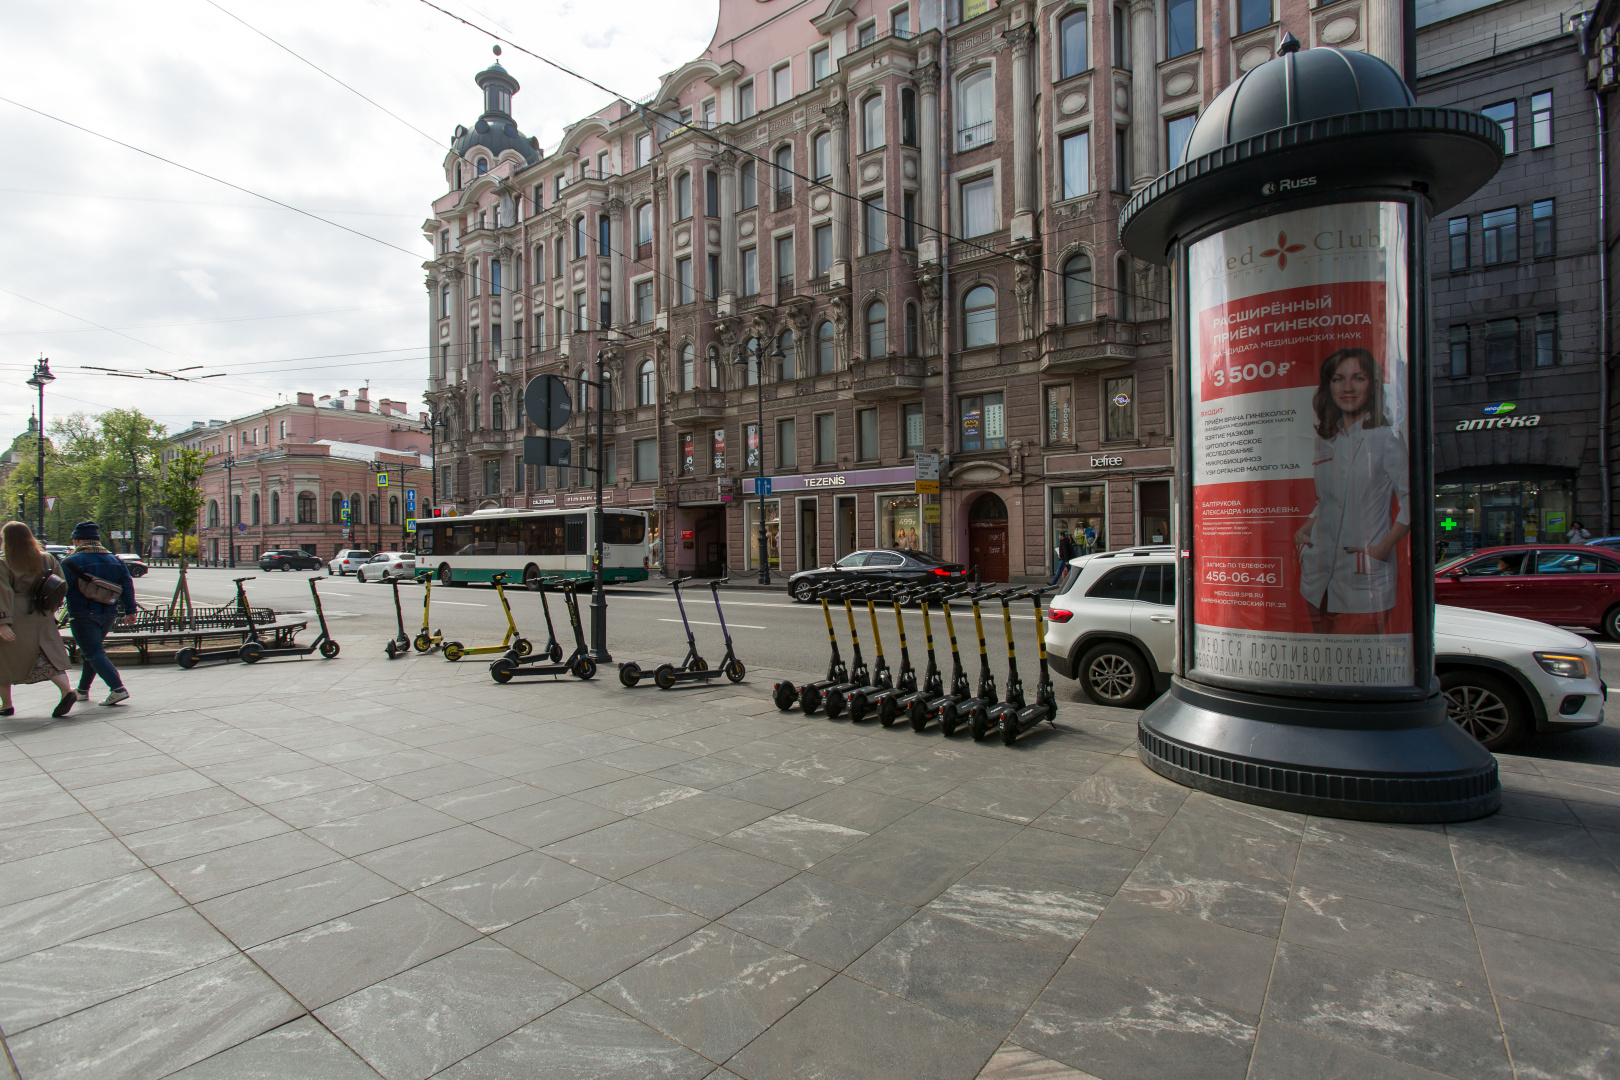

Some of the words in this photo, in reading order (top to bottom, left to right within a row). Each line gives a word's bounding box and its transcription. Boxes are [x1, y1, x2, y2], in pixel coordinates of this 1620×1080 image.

[1280, 176, 1318, 191] Russ
[1313, 228, 1380, 251] Club
[1213, 294, 1332, 329] РАСШИРЁННЫЙ
[1213, 324, 1260, 346] ПРИЁМ
[1264, 313, 1372, 334] ГИНЕКОЛОГА
[1213, 343, 1259, 358] КАНДИДАТА
[1260, 332, 1334, 348] МЕДИЦИНСКИХ
[1337, 331, 1362, 340] НАУК
[1200, 408, 1226, 418] ВХОДИТ:
[1204, 416, 1224, 426] ПРИЁМ
[1224, 414, 1244, 423] ВРАЧА
[1246, 409, 1296, 420] ГИНЕКОЛОГА
[1062, 402, 1070, 440] Massage
[1231, 418, 1274, 428] МЕДИЦИНСКИХ
[1456, 414, 1541, 432] аптека
[1204, 432, 1226, 441] ВЗЯТИЕ
[1226, 429, 1254, 438] МАЗКОВ
[1204, 438, 1262, 450] ЦИТОЛОГИЧЕСКОЕ
[1206, 446, 1254, 458] ИССЛЕДОВАНИЕ
[1090, 454, 1123, 468] befree
[1206, 456, 1262, 466] МИКРОБИОЦИНОЗ
[1216, 466, 1245, 474] ОРГАНОВ
[1202, 500, 1242, 508] БАЛТРУКОВА
[1206, 570, 1276, 584] 456-06-46
[1200, 598, 1264, 607] КАМЕННООСТРОВСКИЙ
[1196, 634, 1242, 657] ИМЕЮТСЯ
[1251, 642, 1406, 664] ПРОТИВОПОКАЗАНИЯ
[1196, 652, 1244, 674] НЕОБХОДИМА
[1248, 660, 1332, 684] КОНСУЛЬТАЦИЯ
[1338, 666, 1406, 686] СПЕЦИАЛИСТА
